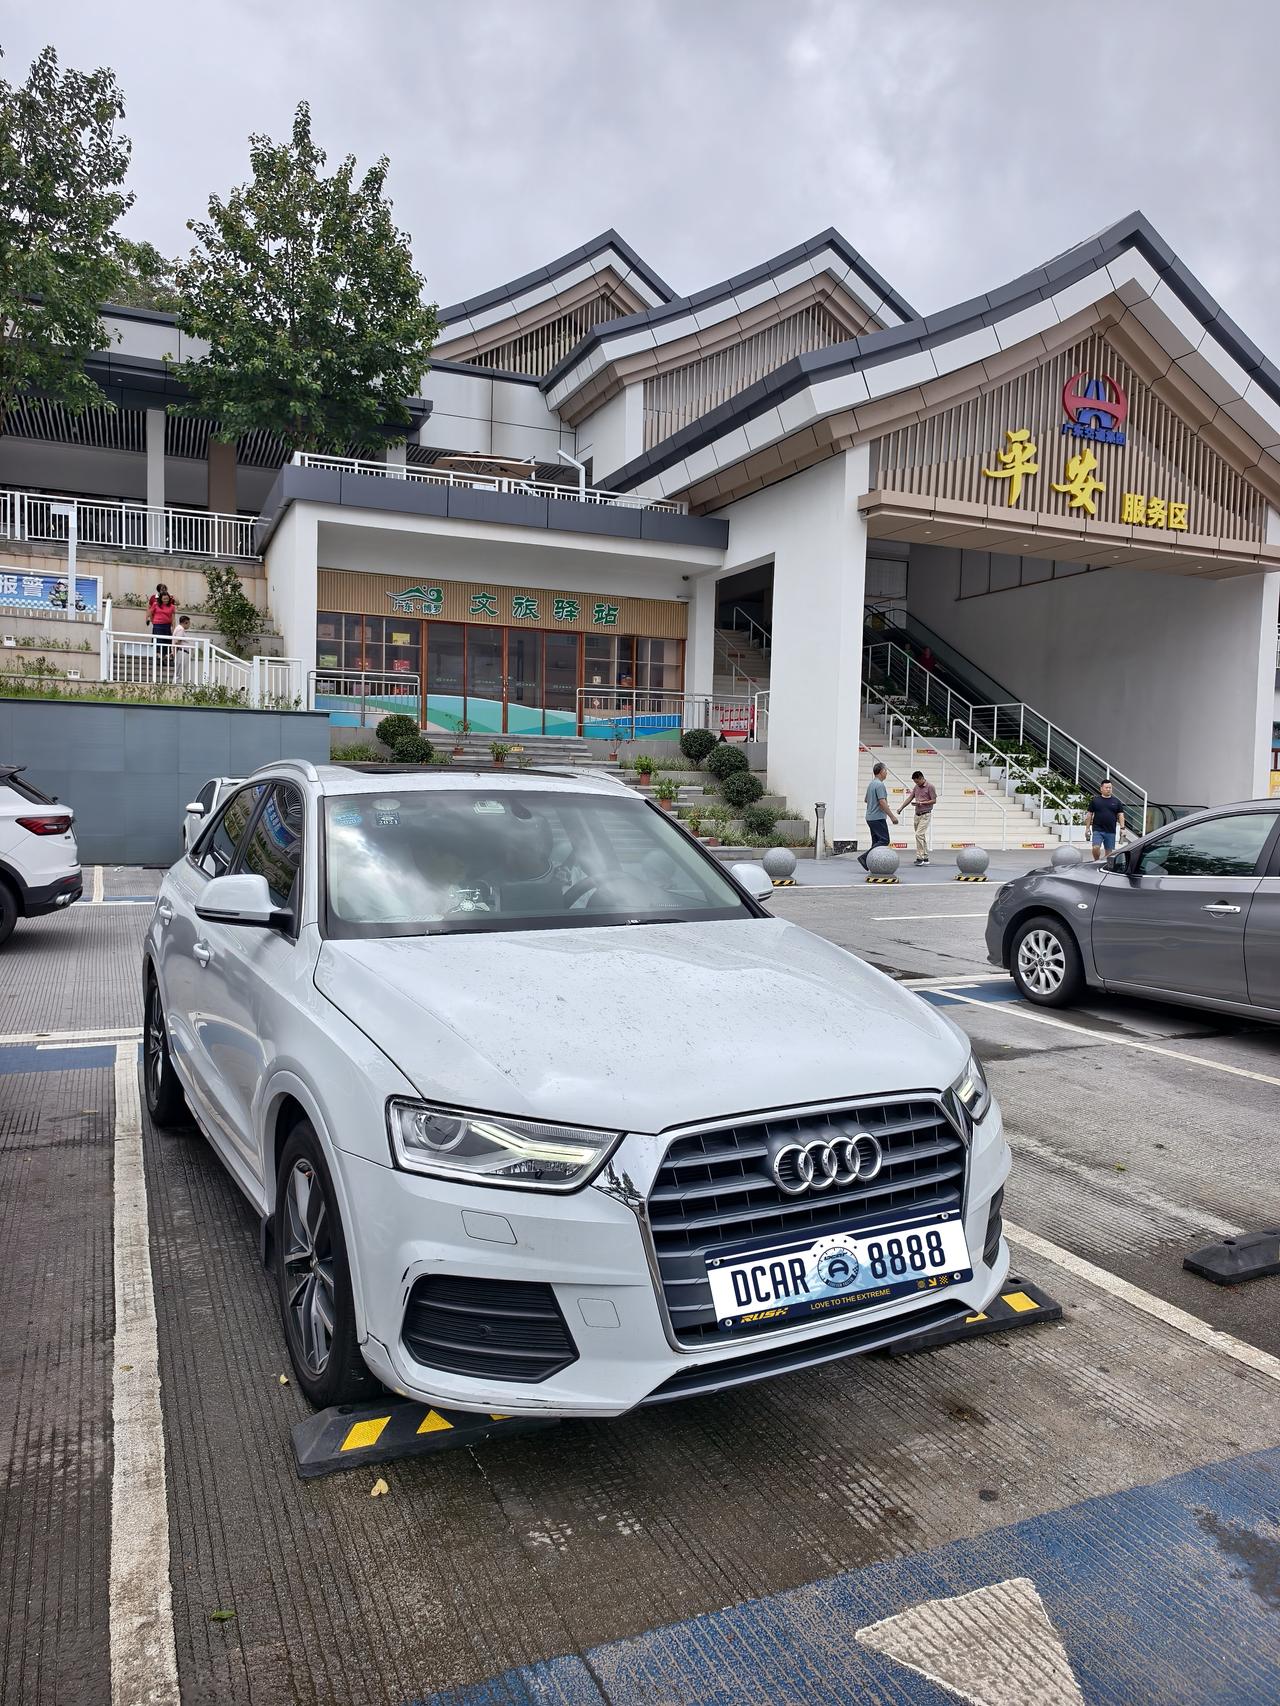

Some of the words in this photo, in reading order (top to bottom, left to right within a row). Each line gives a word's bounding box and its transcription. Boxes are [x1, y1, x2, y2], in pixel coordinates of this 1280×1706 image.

[982, 429, 1106, 514] 平安
[1122, 492, 1189, 530] 服务区
[0, 574, 44, 598] 报警
[469, 591, 620, 627] 文旅驿站
[867, 1230, 946, 1279] 8888
[731, 1257, 811, 1308] DCAR
[810, 1300, 830, 1311] LOVE
[830, 1298, 841, 1306] TO
[841, 1295, 857, 1304] THE
[857, 1288, 891, 1301] EXTREME
